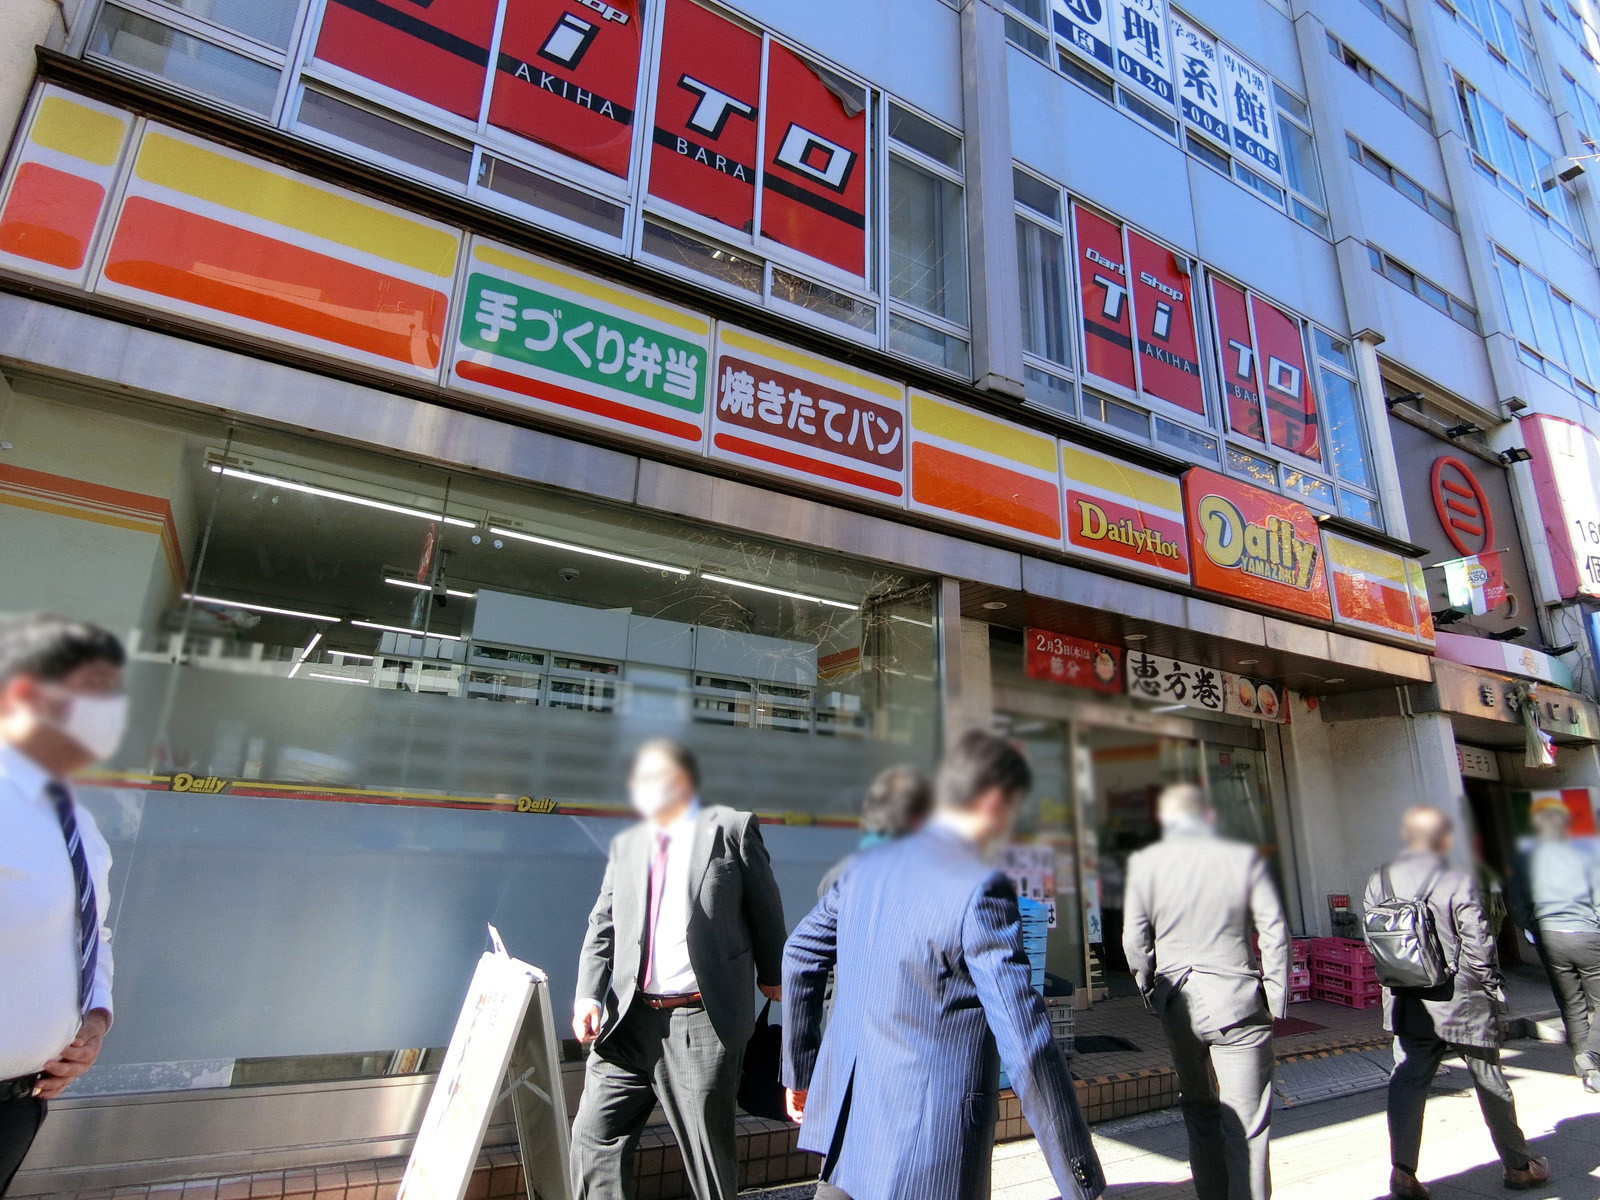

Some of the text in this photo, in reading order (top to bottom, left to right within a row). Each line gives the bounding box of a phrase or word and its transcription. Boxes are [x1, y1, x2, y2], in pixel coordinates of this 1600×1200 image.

[514, 62, 747, 183] AKIHA BARA
[1139, 271, 1184, 302] Shop
[475, 288, 699, 401] 手づくり弁当
[1145, 342, 1259, 406] AKIHA BAR
[720, 365, 901, 455] 焼きたてパン
[1201, 495, 1317, 590] Daily
[1241, 555, 1297, 585] YAMAZAKI
[1036, 634, 1091, 660] 2月3日(木)は
[1130, 652, 1221, 709] 恵方巻
[173, 772, 229, 794] Daily
[517, 795, 557, 813] Daily
